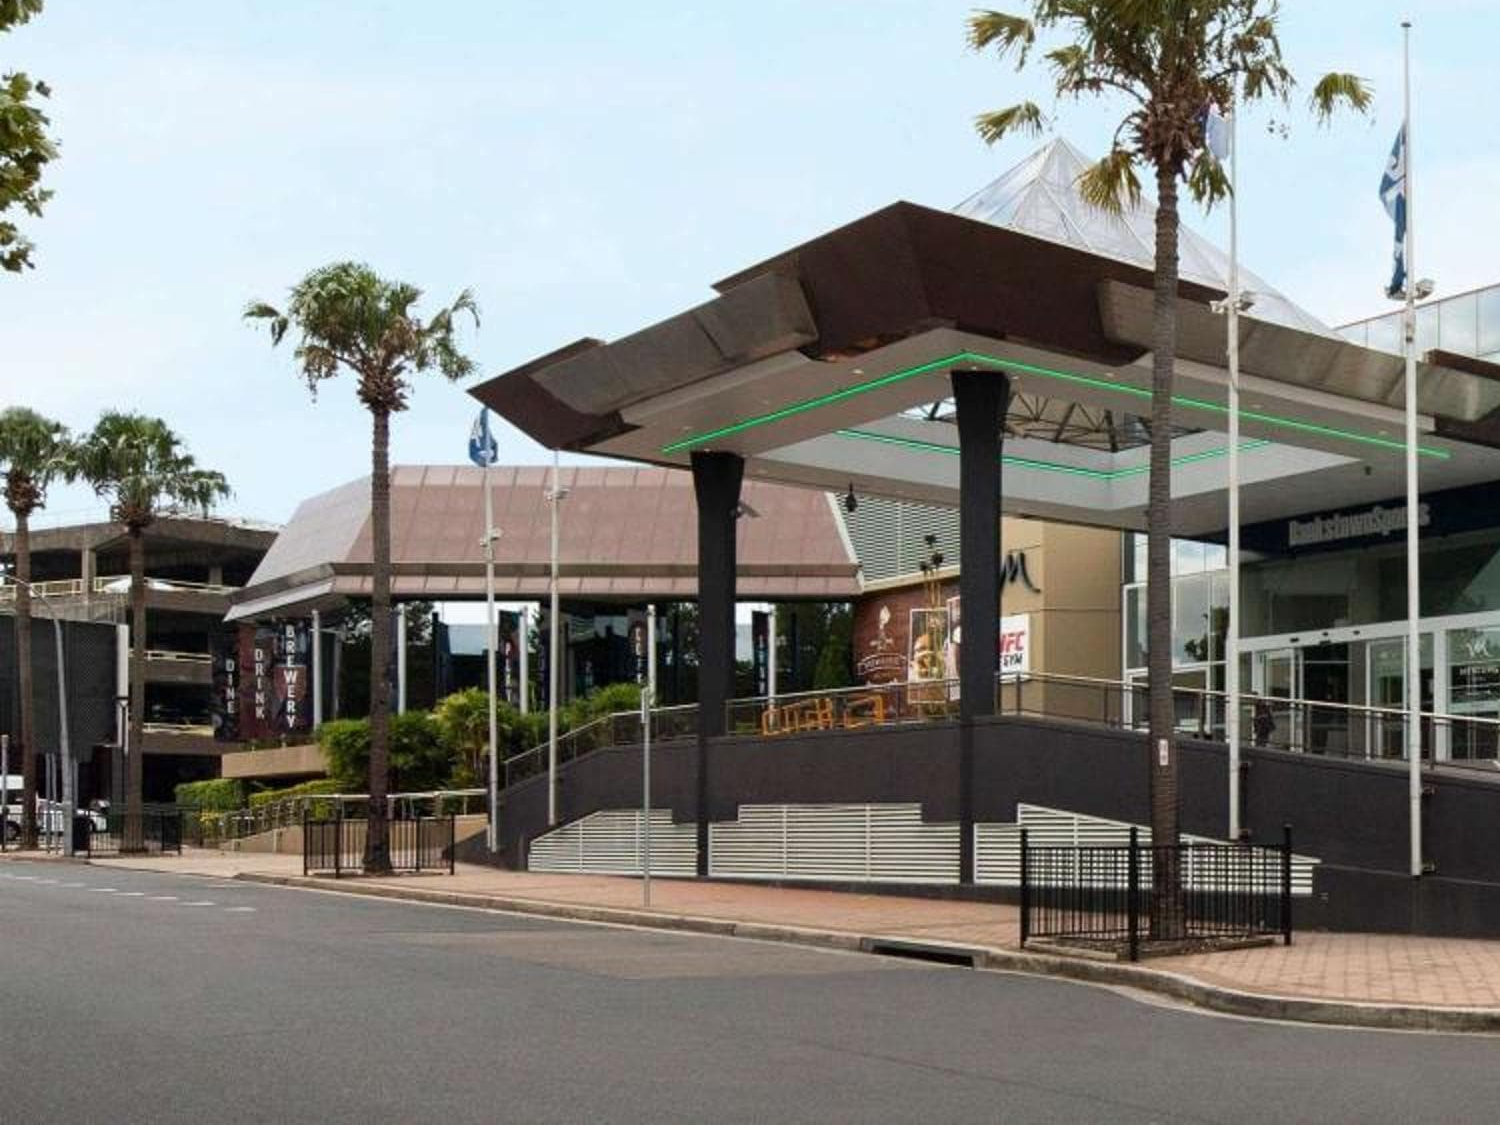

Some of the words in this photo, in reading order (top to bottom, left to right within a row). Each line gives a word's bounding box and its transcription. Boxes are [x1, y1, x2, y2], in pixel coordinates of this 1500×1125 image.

[1289, 502, 1431, 546] BankstownSpors
[225, 658, 236, 714] DINE
[255, 648, 265, 719] DRINK
[283, 624, 298, 728] BREWERY
